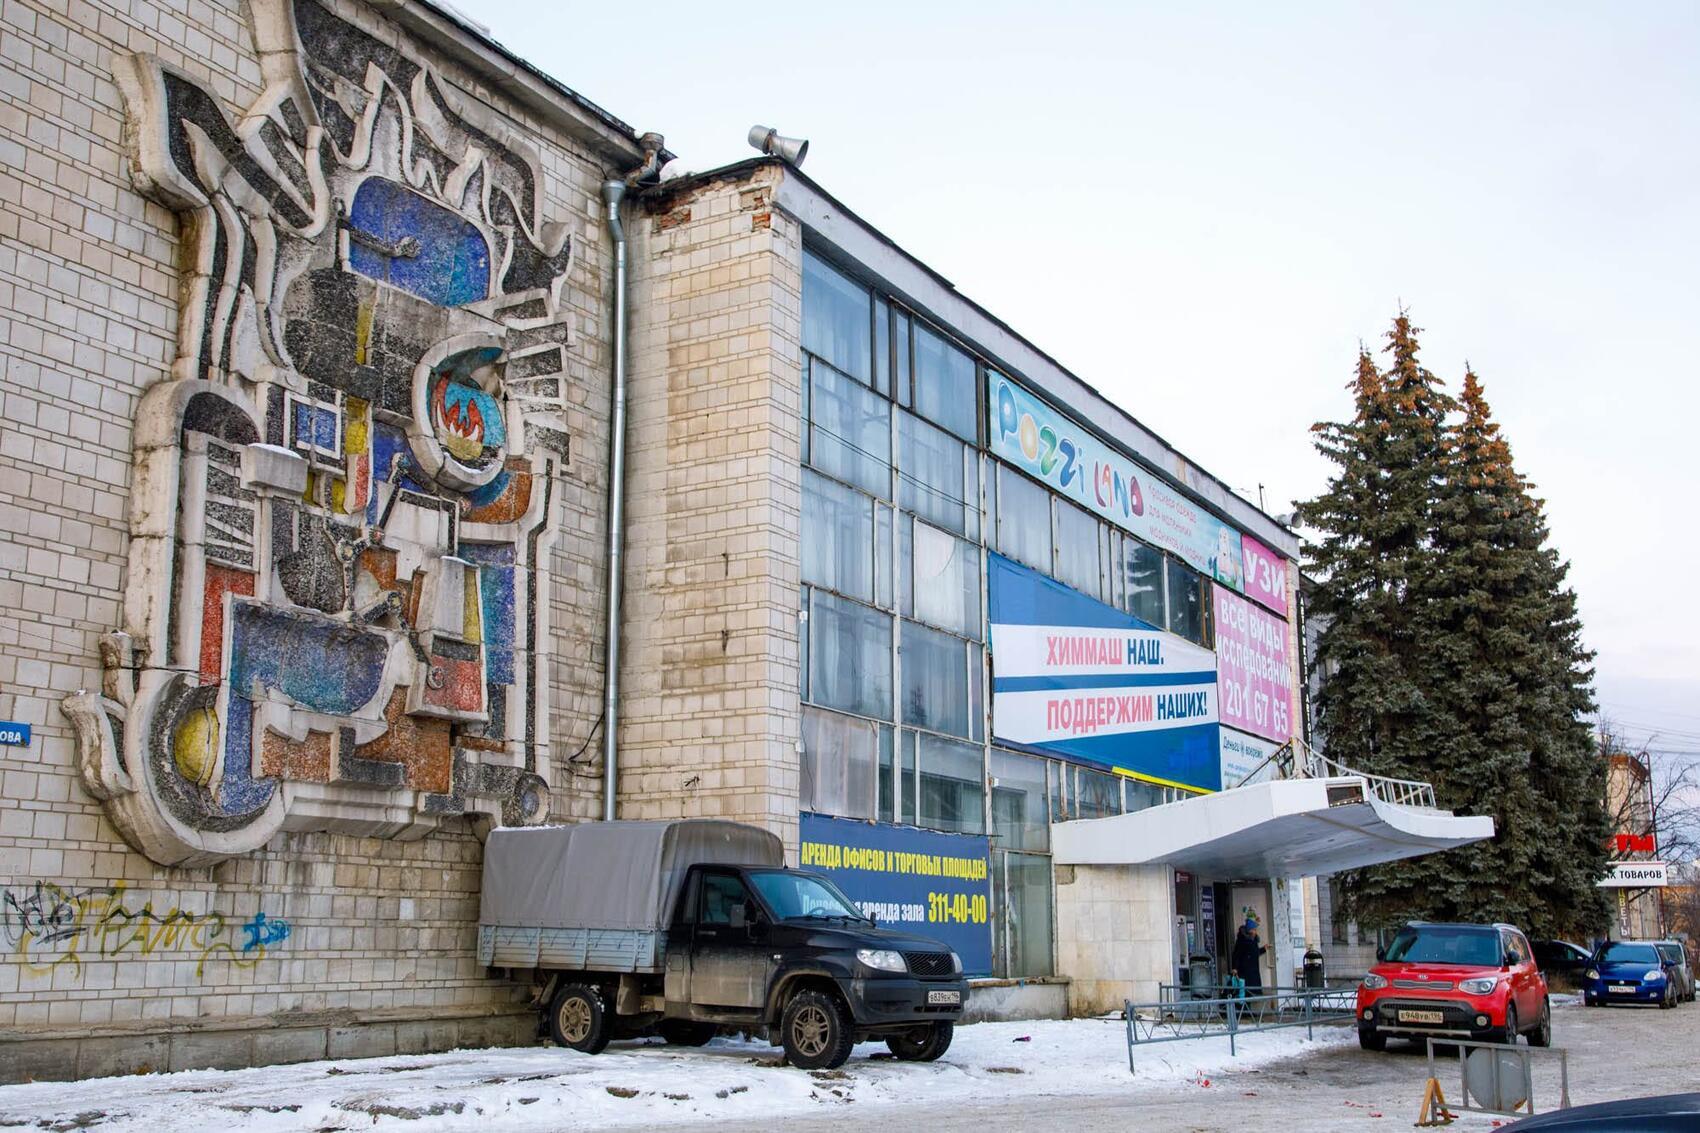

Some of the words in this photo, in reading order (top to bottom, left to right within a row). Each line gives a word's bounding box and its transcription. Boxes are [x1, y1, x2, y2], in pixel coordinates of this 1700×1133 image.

[1245, 548, 1286, 602] УЗИ
[1047, 636, 1122, 666] ХИММАШ
[1127, 638, 1164, 665] НАШ.
[1047, 695, 1153, 735] ПОДДЕРЖИМ
[1157, 691, 1207, 720] НАШИХ!
[1226, 678, 1249, 720] 201
[1254, 690, 1268, 728] 67
[1273, 698, 1288, 734] 65
[0, 730, 21, 743] ОВА
[801, 841, 841, 870] АРЕНДА
[843, 846, 885, 872] ОФИСОВ
[887, 851, 893, 873] И
[895, 852, 941, 876] ТОРГОВЫХ
[943, 856, 987, 881] ПЛОЩАДЕЙ
[1619, 870, 1662, 880] ТОВАРОВ
[862, 901, 900, 924] аренда
[901, 903, 925, 922] зала
[927, 892, 987, 924] 311-40-00
